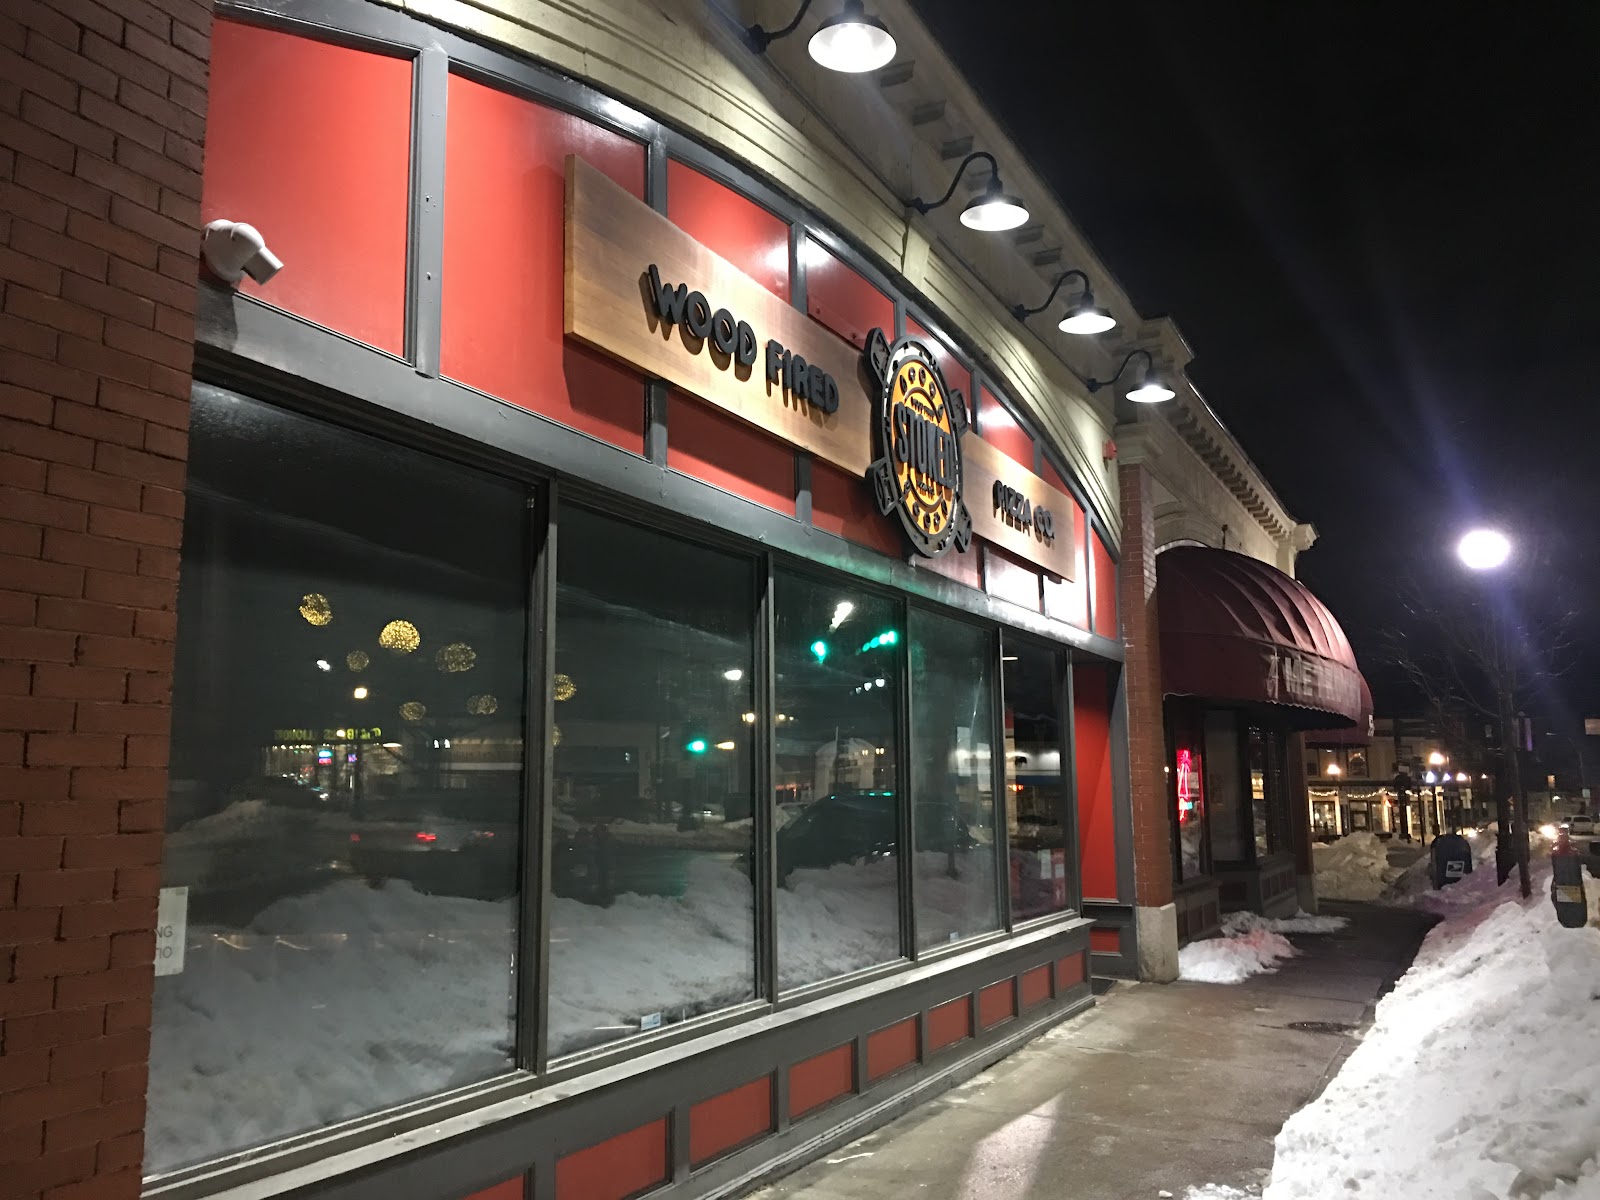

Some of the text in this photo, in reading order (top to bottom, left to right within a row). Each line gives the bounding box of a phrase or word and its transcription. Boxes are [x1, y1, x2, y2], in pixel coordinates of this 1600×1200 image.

[648, 263, 840, 415] WOOD FIRED
[895, 401, 957, 489] STOKED
[993, 480, 1033, 527] PIZZA
